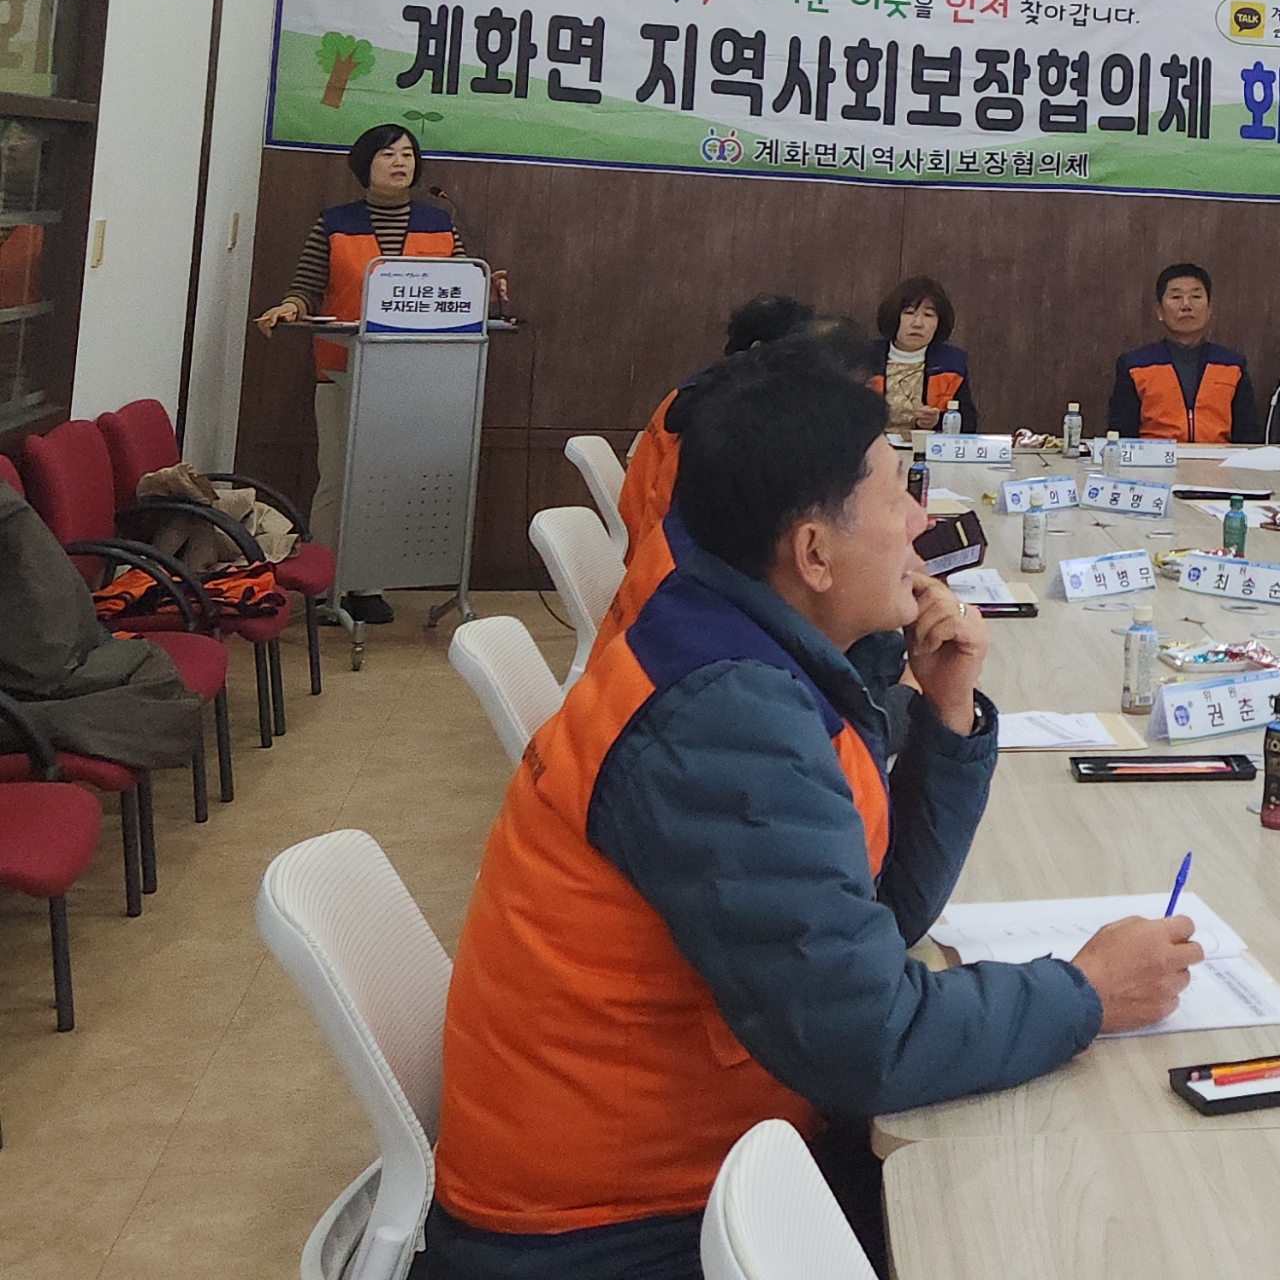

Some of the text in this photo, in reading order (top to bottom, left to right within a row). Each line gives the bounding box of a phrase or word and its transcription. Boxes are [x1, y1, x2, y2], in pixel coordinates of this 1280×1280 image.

[1019, 0, 1140, 27] 찾아갑니다.
[1236, 13, 1259, 24] TALK
[396, 4, 605, 105] 계화면
[635, 23, 1211, 140] 지역사회보장협의체
[754, 138, 1090, 179] 계화면지역사회보장협의체
[393, 286, 461, 298] 더 나은 농촌
[380, 300, 471, 313] 부자되는 계화면
